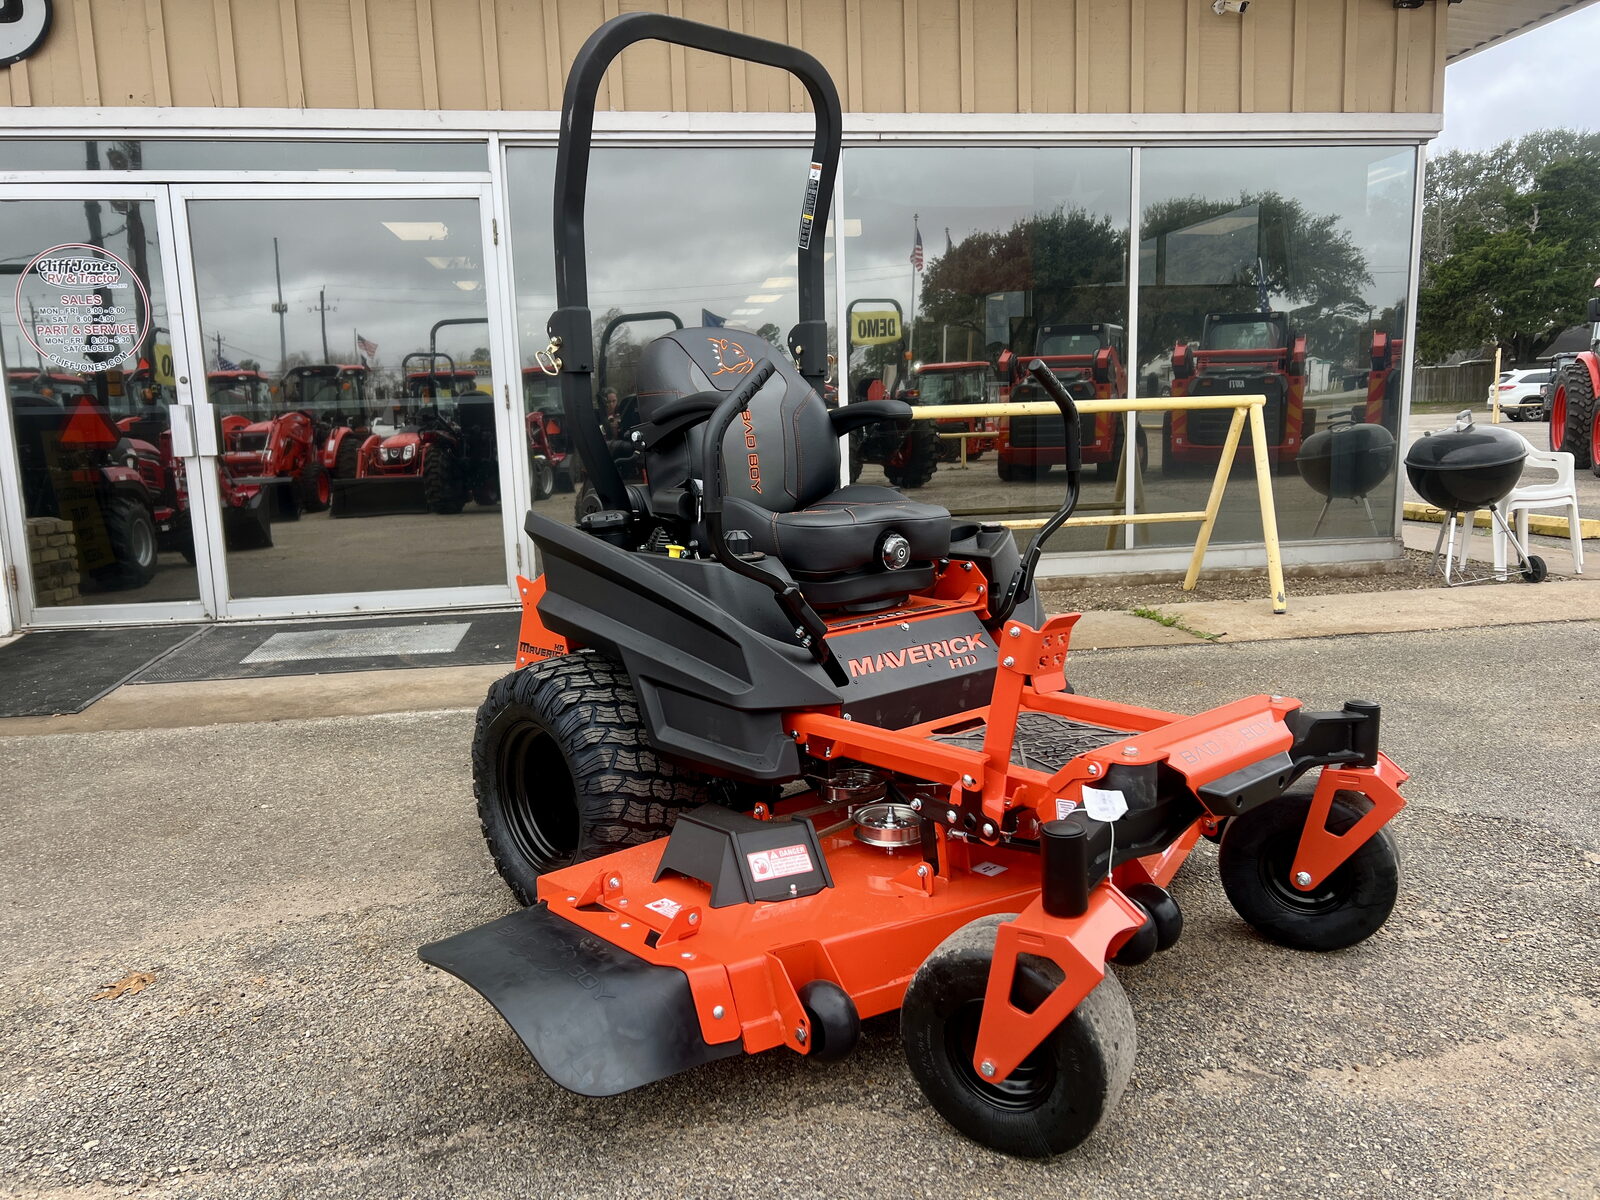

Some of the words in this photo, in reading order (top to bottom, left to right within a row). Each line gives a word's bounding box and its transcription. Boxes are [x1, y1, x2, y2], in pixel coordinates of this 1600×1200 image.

[37, 259, 71, 274] Cliff
[73, 259, 117, 273] Jones
[47, 273, 64, 283] RV
[66, 273, 75, 283] &
[79, 273, 119, 283] Tractor
[61, 295, 102, 305] SALES
[37, 325, 68, 335] PART
[72, 325, 80, 334] &
[84, 324, 137, 334] SERVICE
[49, 351, 128, 371] CLIFFJONES.COM
[741, 408, 757, 449] BAD
[747, 453, 763, 495] BOY
[553, 643, 564, 652] HD
[848, 632, 988, 678] MAVERICK
[948, 654, 978, 670] HD
[1179, 740, 1226, 765] BAD
[1238, 718, 1277, 741] BOY
[778, 846, 806, 857] DANGER
[568, 964, 617, 1000] BOY
